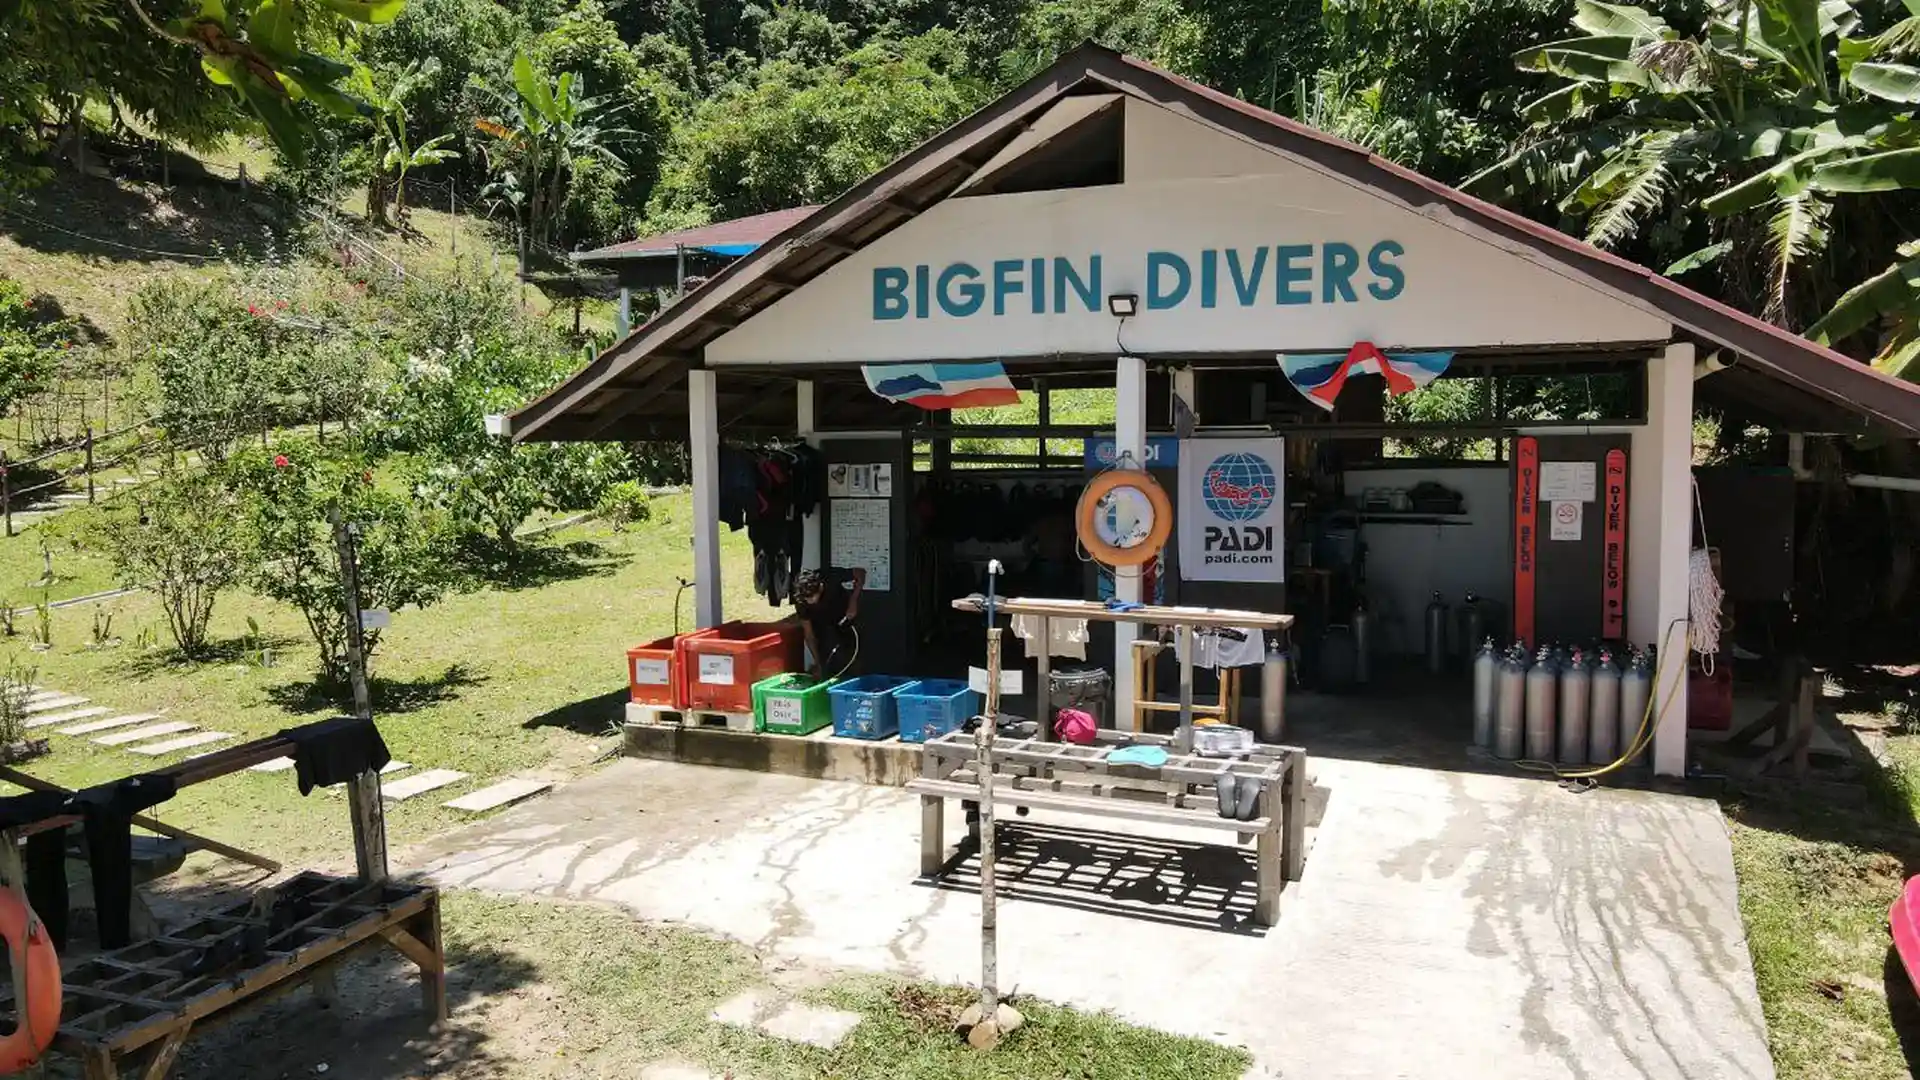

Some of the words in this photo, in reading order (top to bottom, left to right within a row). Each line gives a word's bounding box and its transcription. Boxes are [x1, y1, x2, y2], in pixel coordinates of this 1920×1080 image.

[873, 254, 1102, 321] BIGFIN
[1146, 240, 1406, 310] DIVERS
[1522, 468, 1533, 515] DIVER
[1609, 485, 1620, 531] DIVER
[1205, 526, 1273, 551] PADI
[1205, 553, 1273, 565] padi.com
[1520, 525, 1530, 573] BELOW
[1607, 542, 1618, 589] BELOW
